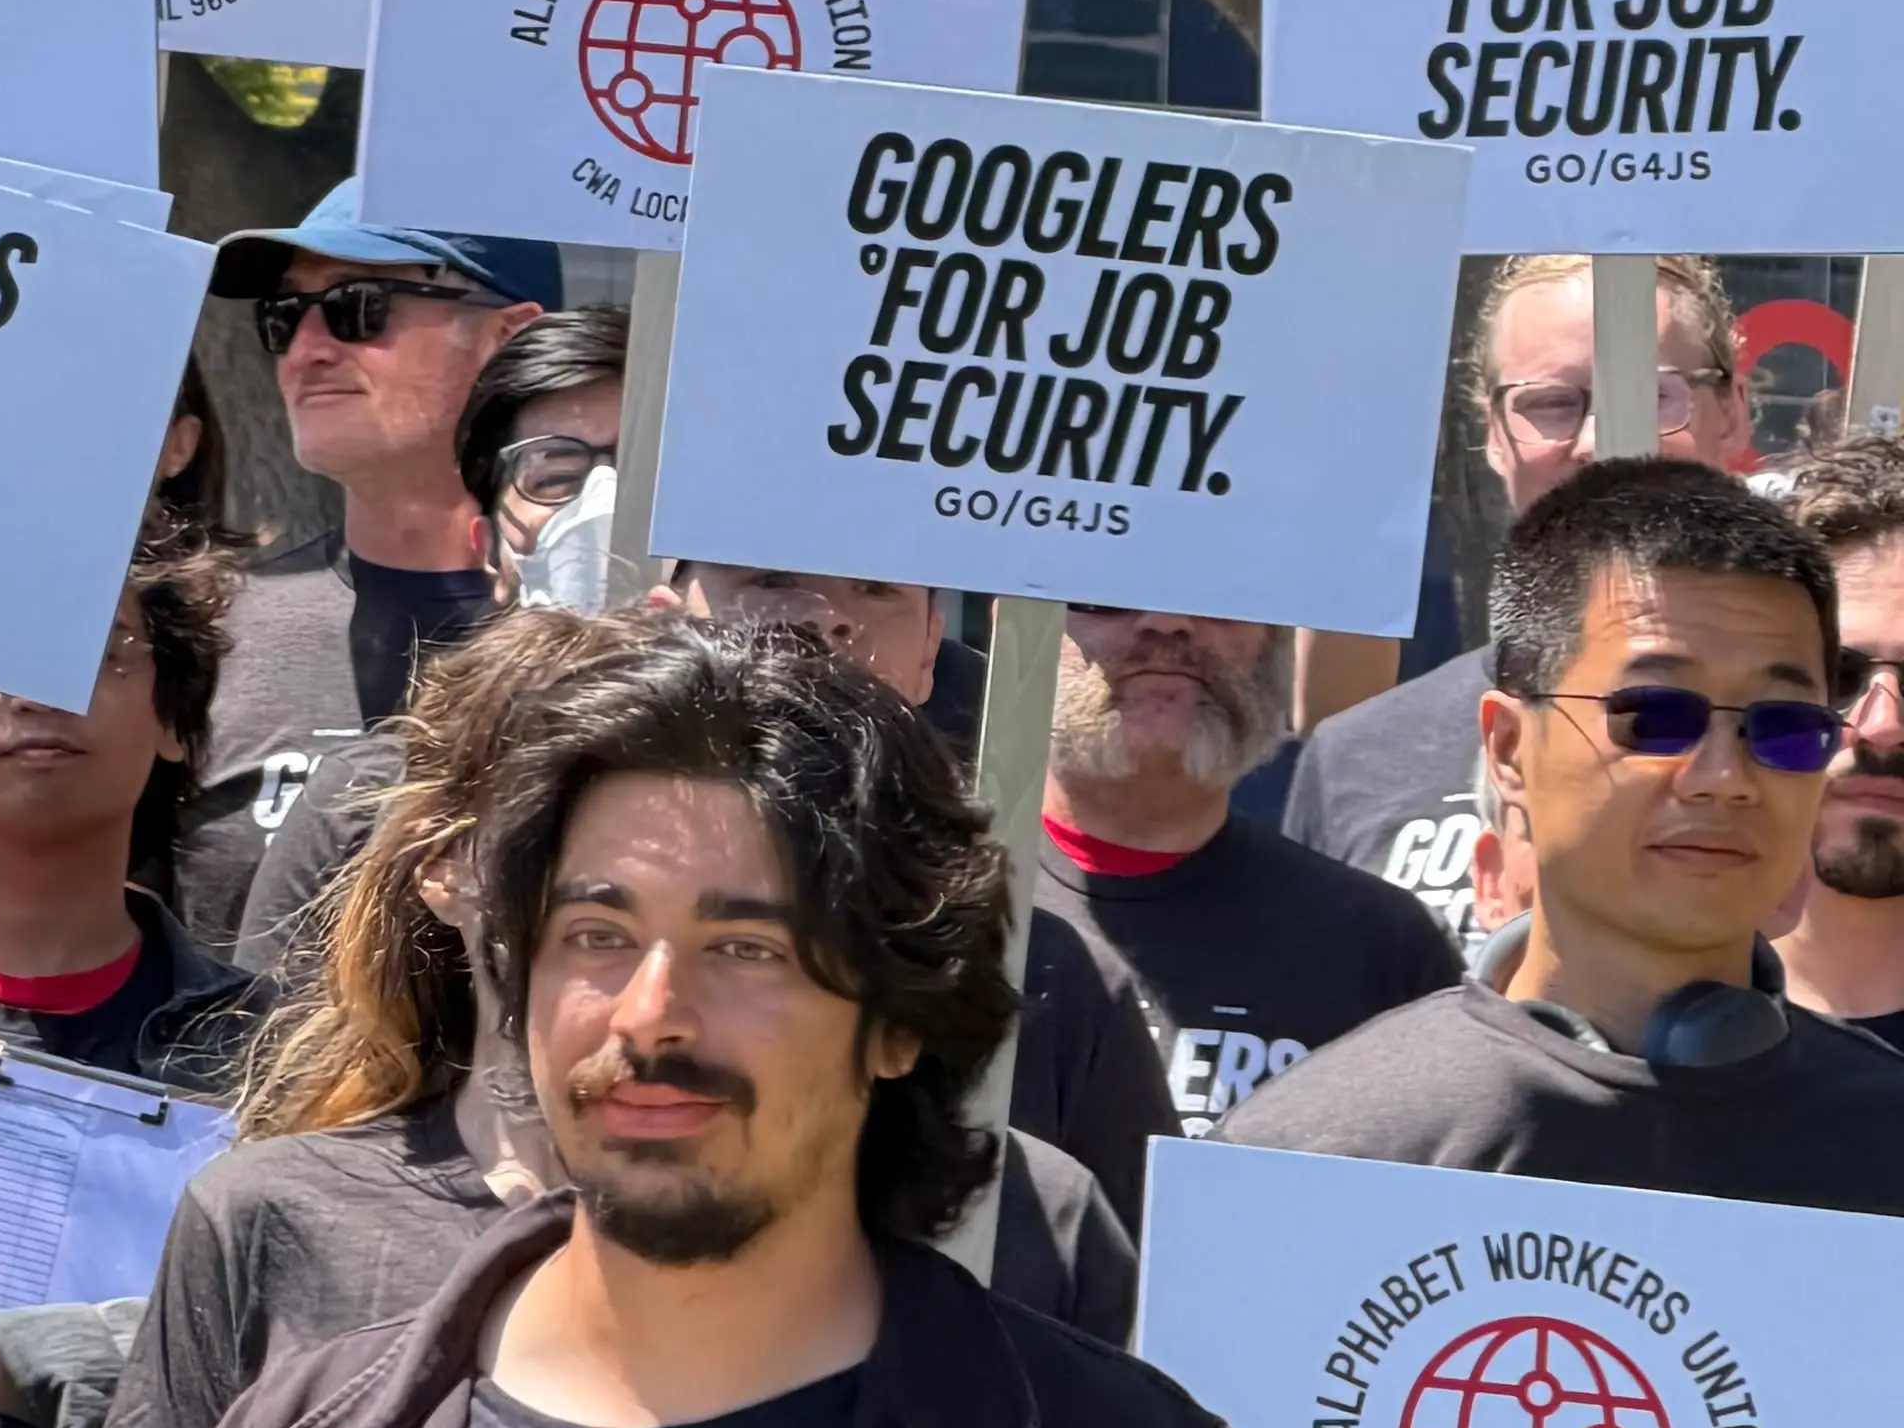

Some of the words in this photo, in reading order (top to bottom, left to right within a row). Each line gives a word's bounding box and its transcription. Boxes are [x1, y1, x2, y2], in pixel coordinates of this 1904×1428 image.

[1417, 35, 1804, 140] SECURITY.
[572, 157, 621, 206] CWA
[630, 187, 688, 224] LOC
[846, 131, 1293, 276] GOOGLERS
[1525, 150, 1712, 186] GO/G4JS
[869, 247, 1045, 362] FOR
[1049, 268, 1233, 381] JOB
[827, 354, 1246, 497] SECURITY.
[934, 485, 1131, 536] GO/G4JS
[1482, 1230, 1691, 1335] WORKERS
